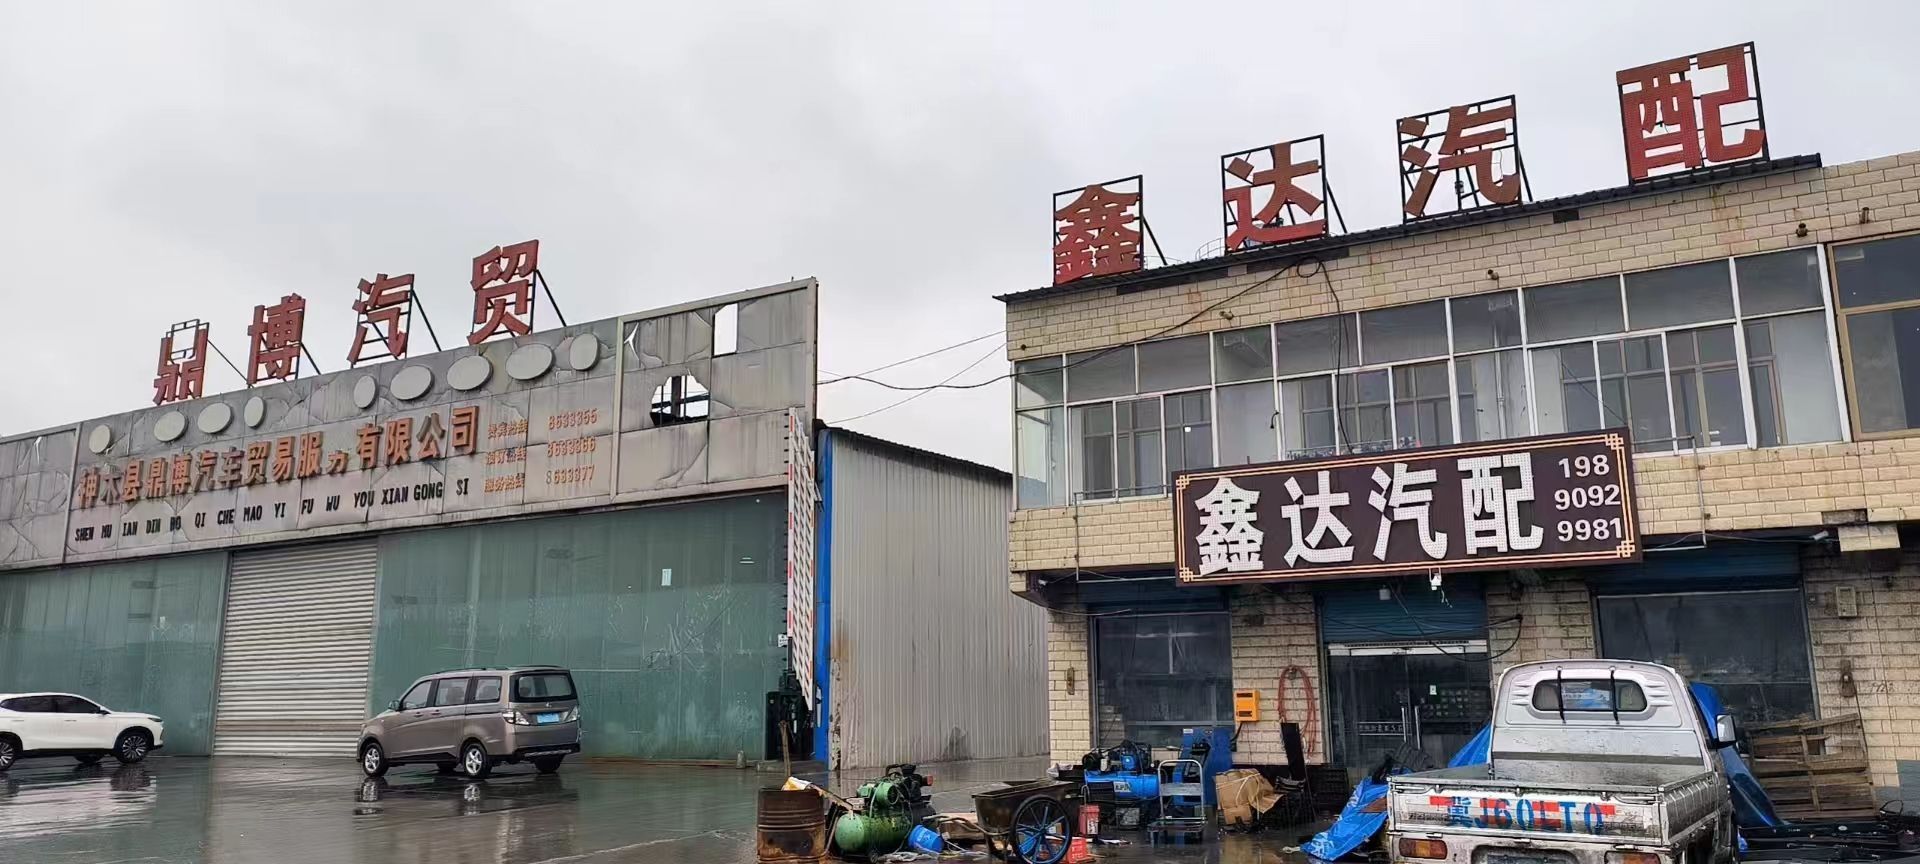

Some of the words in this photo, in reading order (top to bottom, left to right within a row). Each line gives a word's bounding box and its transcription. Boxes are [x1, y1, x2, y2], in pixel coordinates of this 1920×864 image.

[1054, 44, 1766, 282] 鑫达汽配
[545, 464, 595, 485] 8633377
[1558, 454, 1610, 479] 198
[75, 526, 95, 542] SHEN
[101, 524, 112, 539] MU
[195, 511, 206, 528] QI
[217, 508, 235, 525] CHE
[243, 505, 262, 522] MAO
[274, 501, 285, 519] YI
[301, 498, 314, 515] FU
[326, 495, 340, 511] WU
[353, 490, 375, 509] YOU
[381, 486, 408, 505] XIAN
[413, 481, 443, 500] GONG
[456, 478, 469, 496] SI
[1554, 484, 1621, 511] 9092
[1193, 451, 1544, 577] 鑫达汽配
[1557, 517, 1624, 542] 9981
